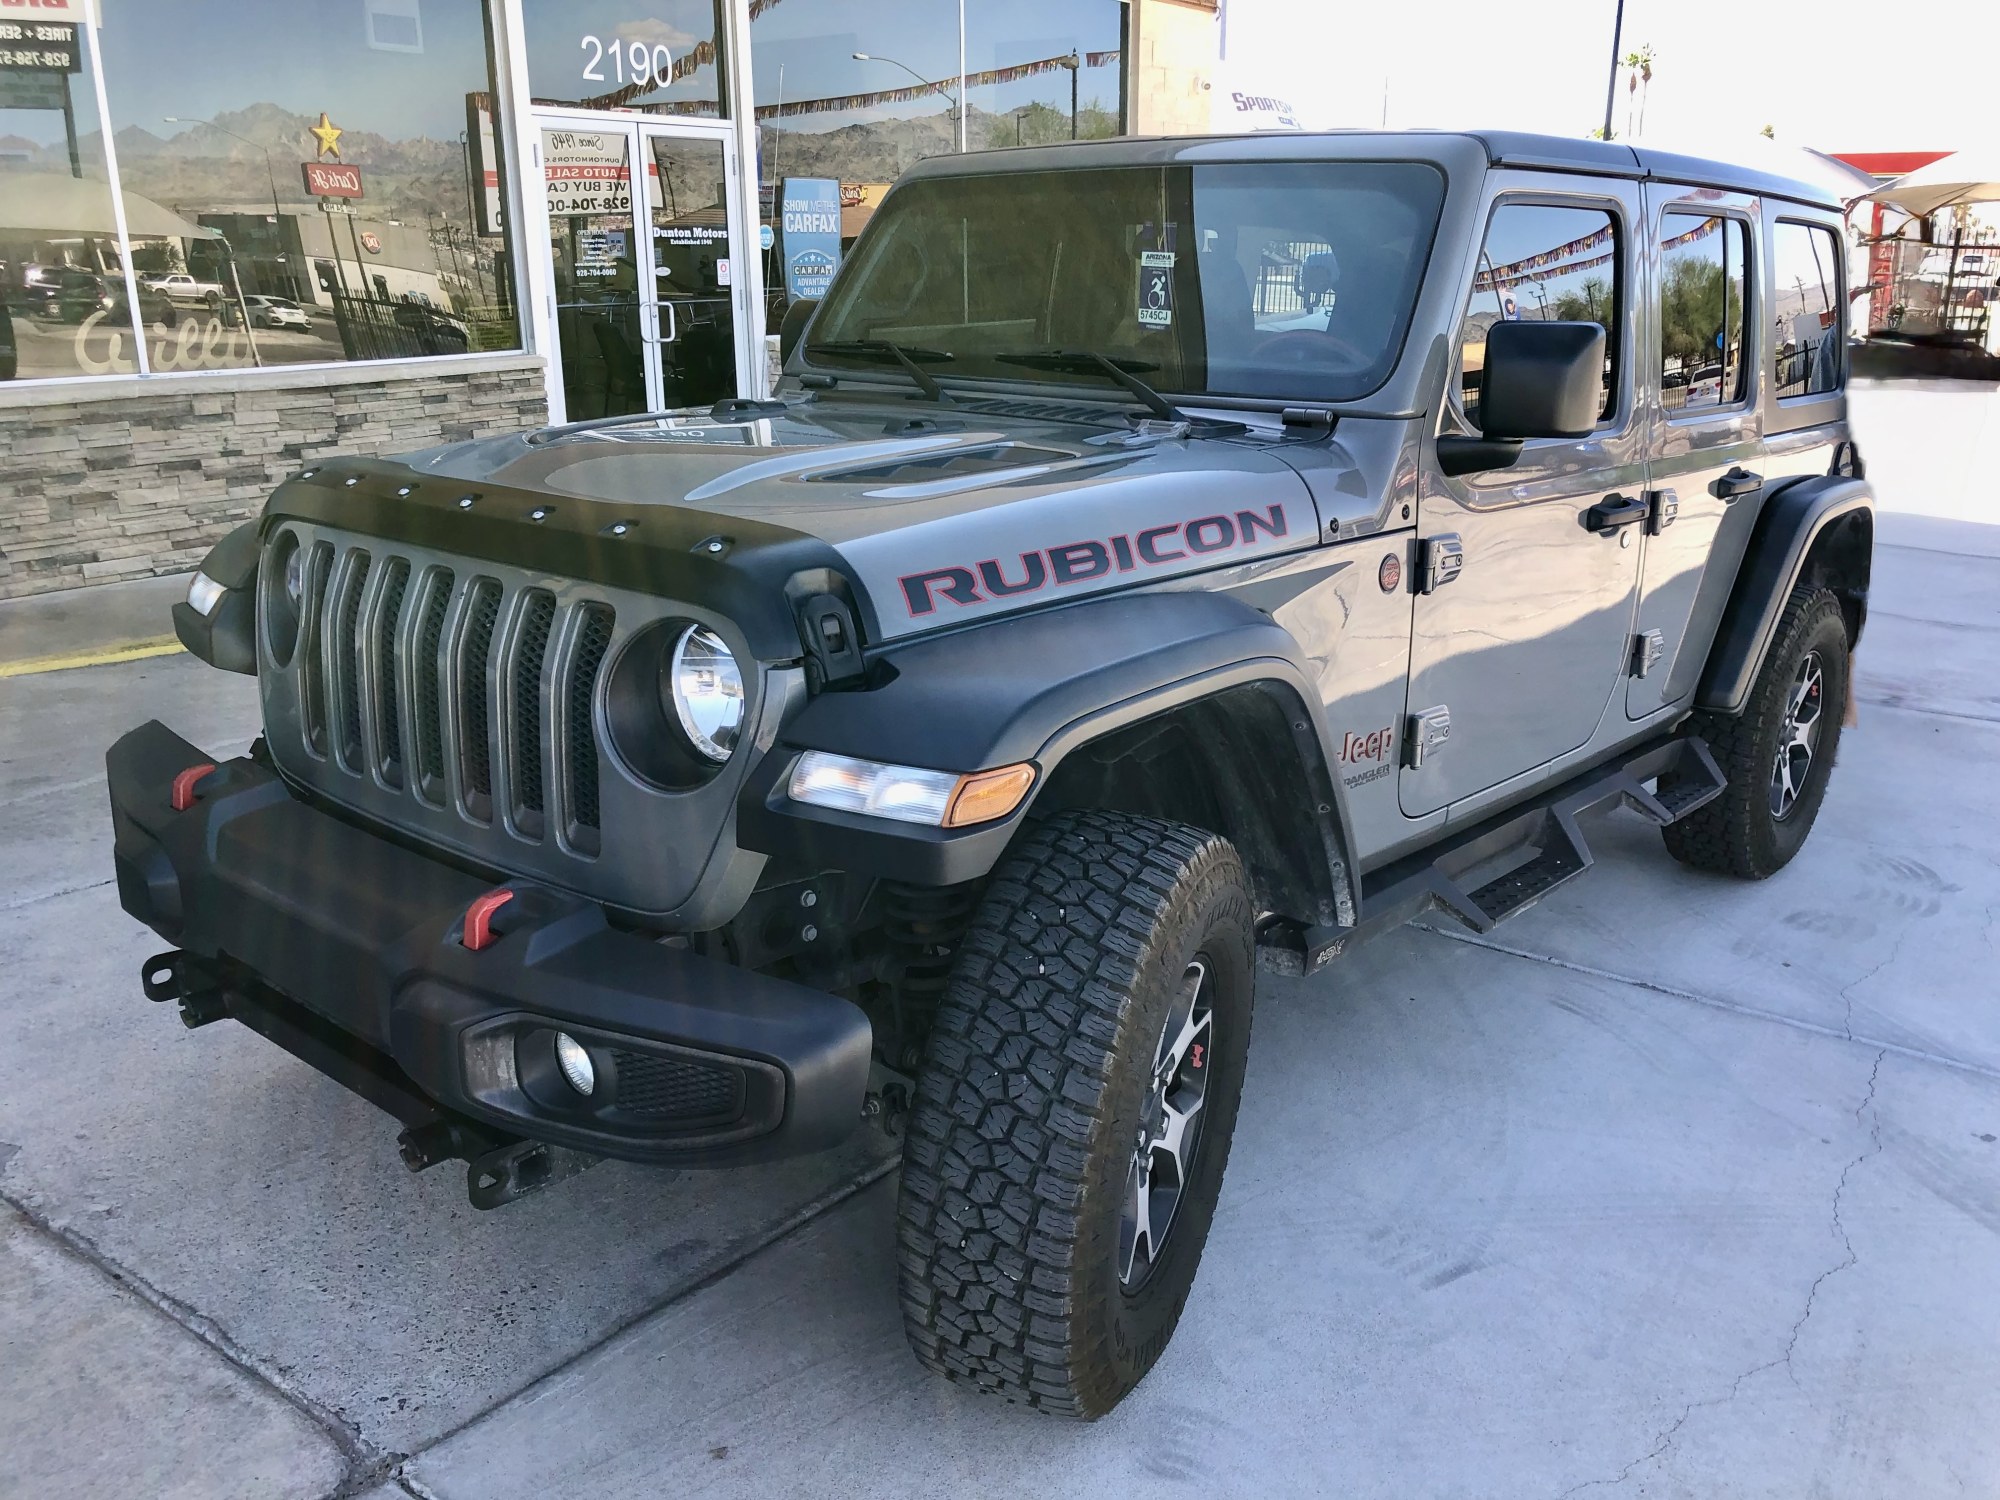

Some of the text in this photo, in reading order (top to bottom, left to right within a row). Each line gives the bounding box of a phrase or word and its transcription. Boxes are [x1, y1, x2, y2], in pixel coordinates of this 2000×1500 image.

[581, 35, 672, 88] 2190
[784, 200, 837, 213] SHOW ME THE
[785, 213, 838, 233] CARFAX
[653, 227, 728, 238] Dunton Motors
[794, 265, 832, 276] CARFAX
[797, 278, 831, 287] ADVANTAGE
[803, 287, 826, 296] DEALER
[1140, 309, 1168, 321] 5745CJ
[897, 503, 1289, 618] RUBICON
[1336, 726, 1393, 764] Jeep
